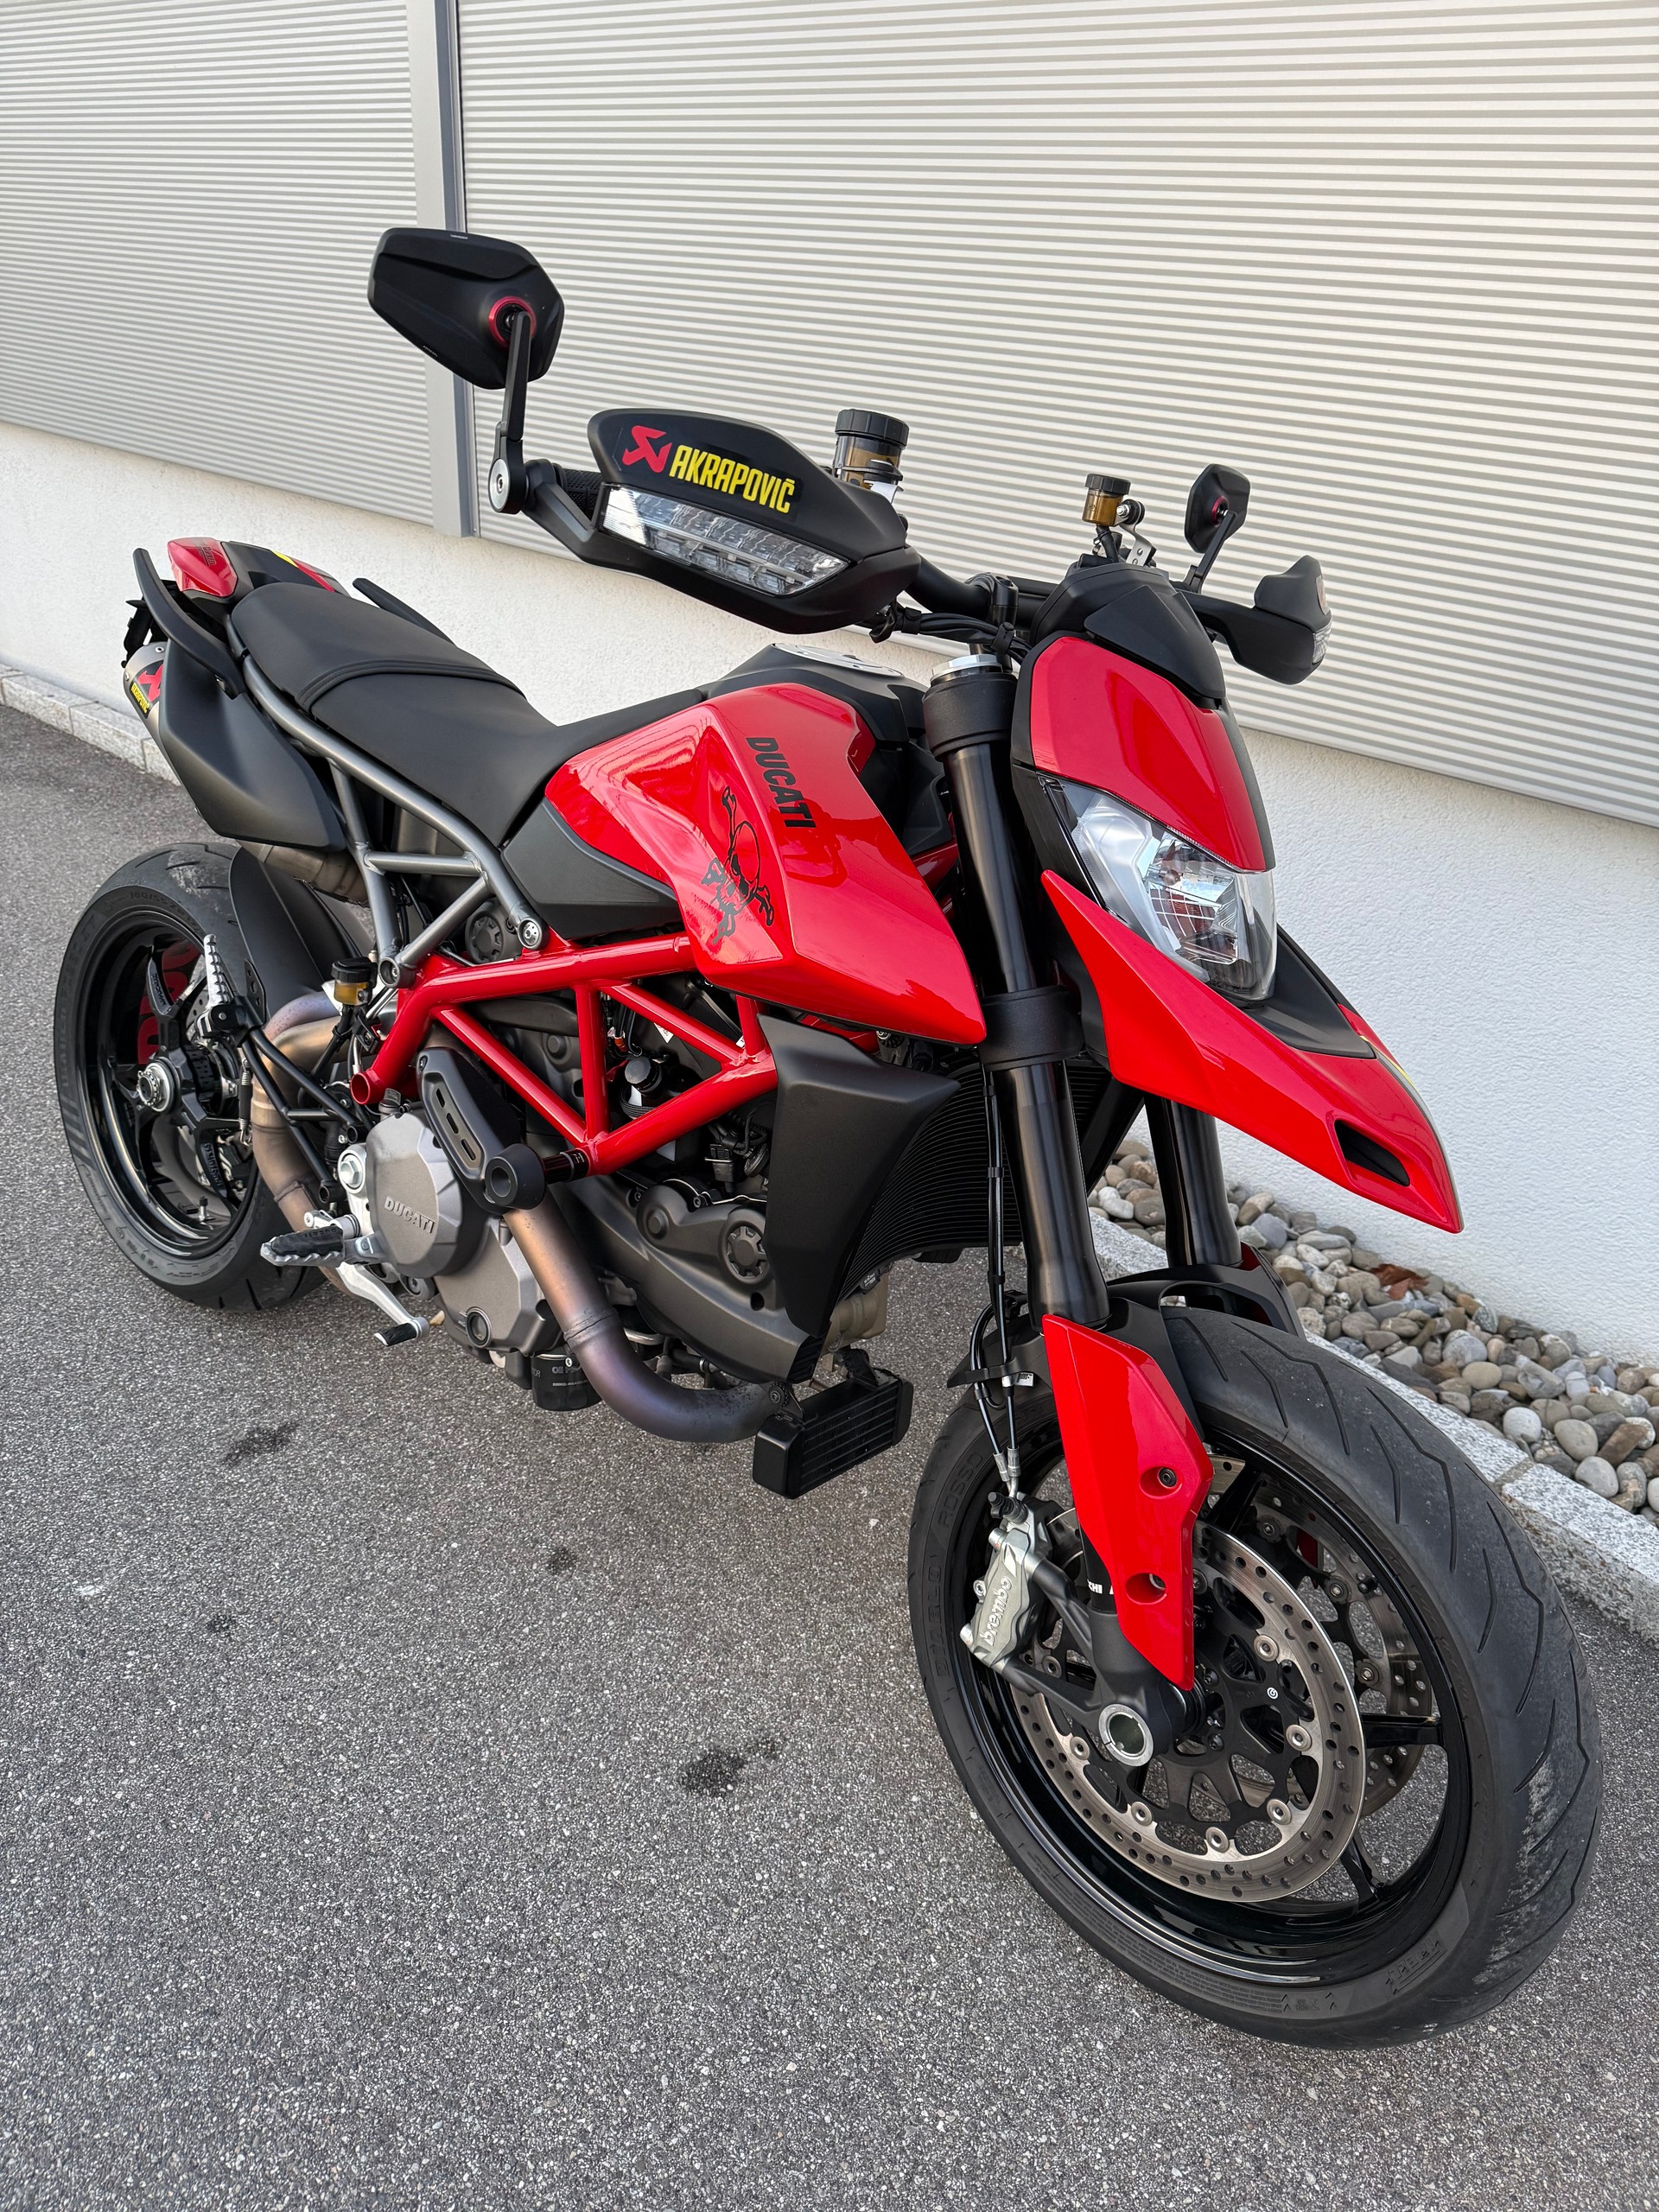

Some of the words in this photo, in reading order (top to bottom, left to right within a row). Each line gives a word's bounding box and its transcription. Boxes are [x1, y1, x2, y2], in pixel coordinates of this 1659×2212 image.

[669, 444, 796, 514] AKRAPOVIČ
[746, 737, 817, 828] DUCATI
[384, 1196, 435, 1234] DUCATI
[938, 1452, 983, 1529] ROSSO
[980, 1576, 1012, 1646] brembo
